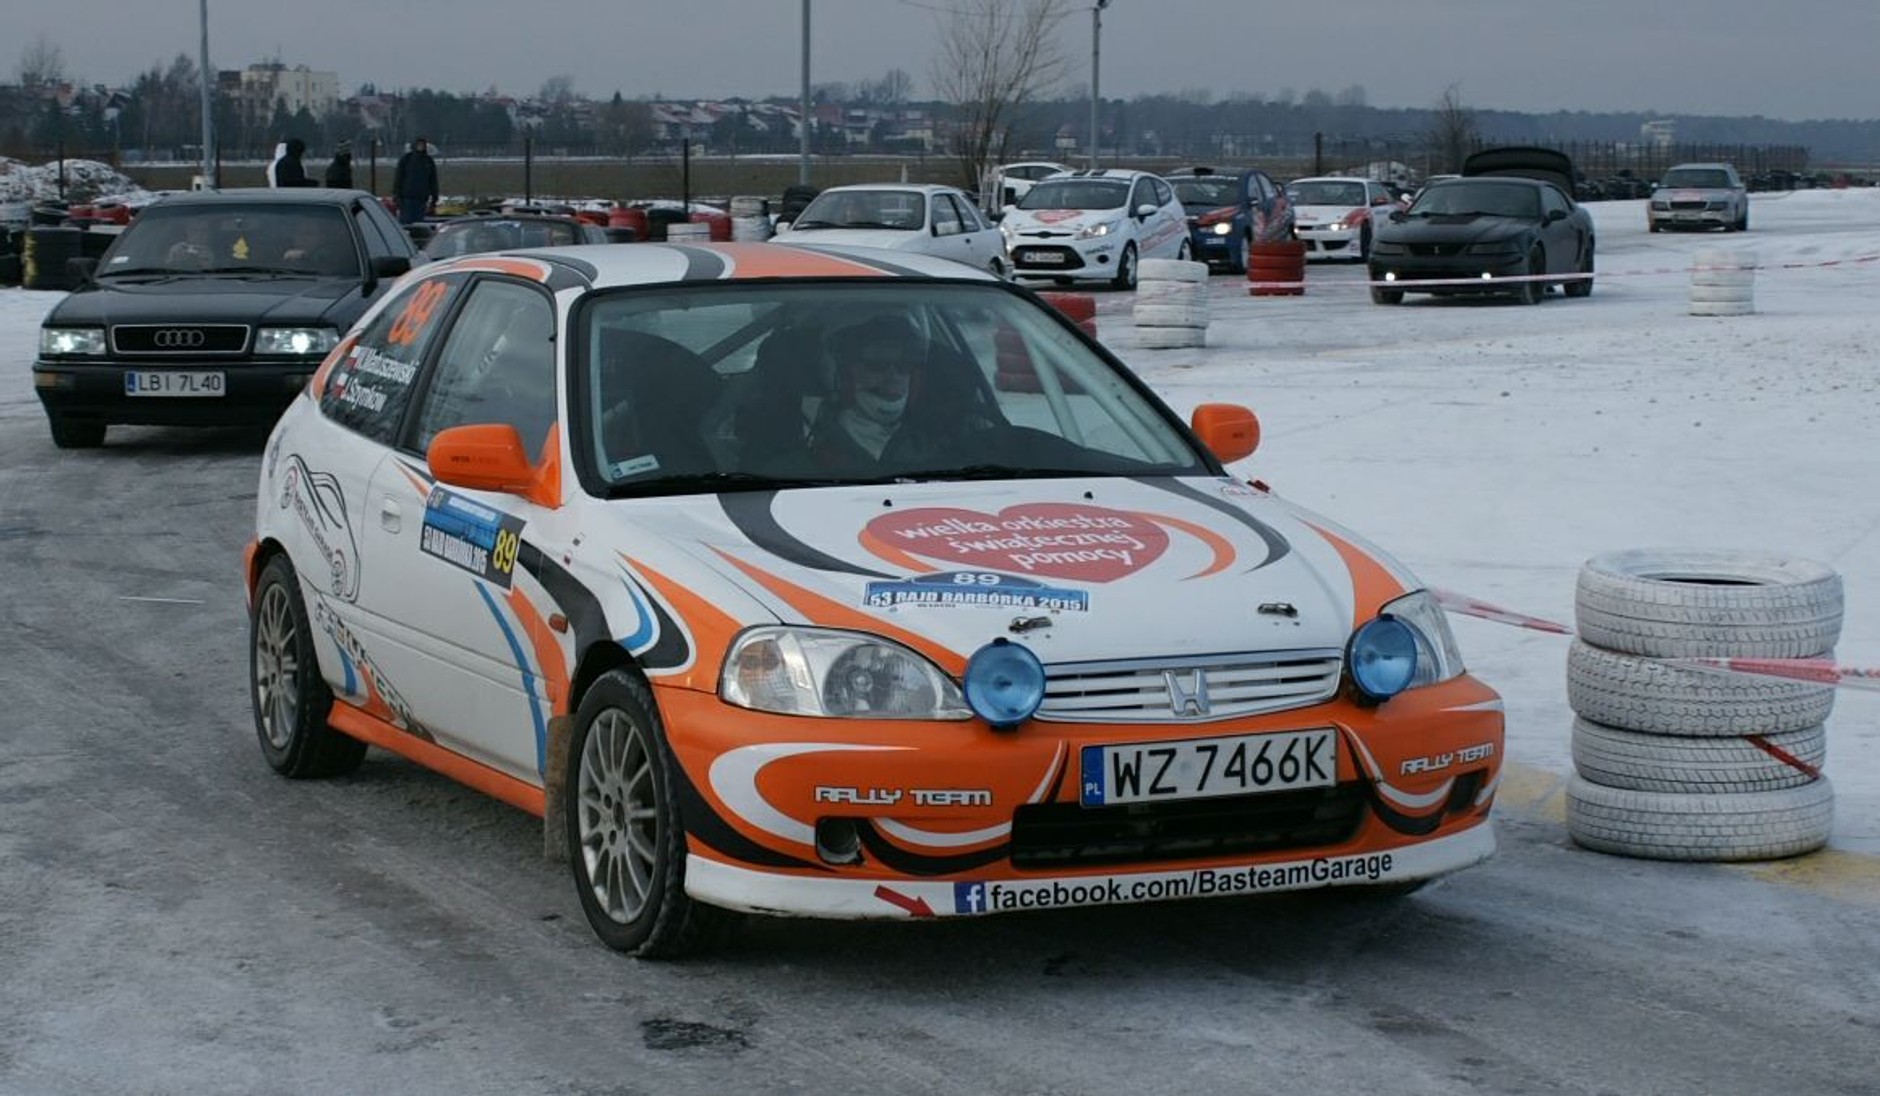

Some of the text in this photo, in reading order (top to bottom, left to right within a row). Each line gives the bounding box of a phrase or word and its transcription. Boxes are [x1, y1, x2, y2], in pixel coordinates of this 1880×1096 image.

[387, 279, 448, 347] 89
[139, 374, 221, 392] LBI 7L40
[894, 518, 1000, 539] wielka
[1001, 515, 1134, 531] orkiestra
[492, 528, 517, 574] 89
[948, 530, 1145, 553] świątecznej
[1008, 549, 1133, 570] pomocy
[953, 573, 1000, 585] 89
[870, 591, 1082, 611] 53 RAJD BARBÓRKA 2015
[1113, 735, 1329, 798] WZ 7466K
[1400, 742, 1494, 776] RALLY TEAM
[815, 786, 992, 806] RALLY TEAM
[1086, 783, 1102, 796] PL
[990, 853, 1394, 911] facebook.com/BasteamGarage
